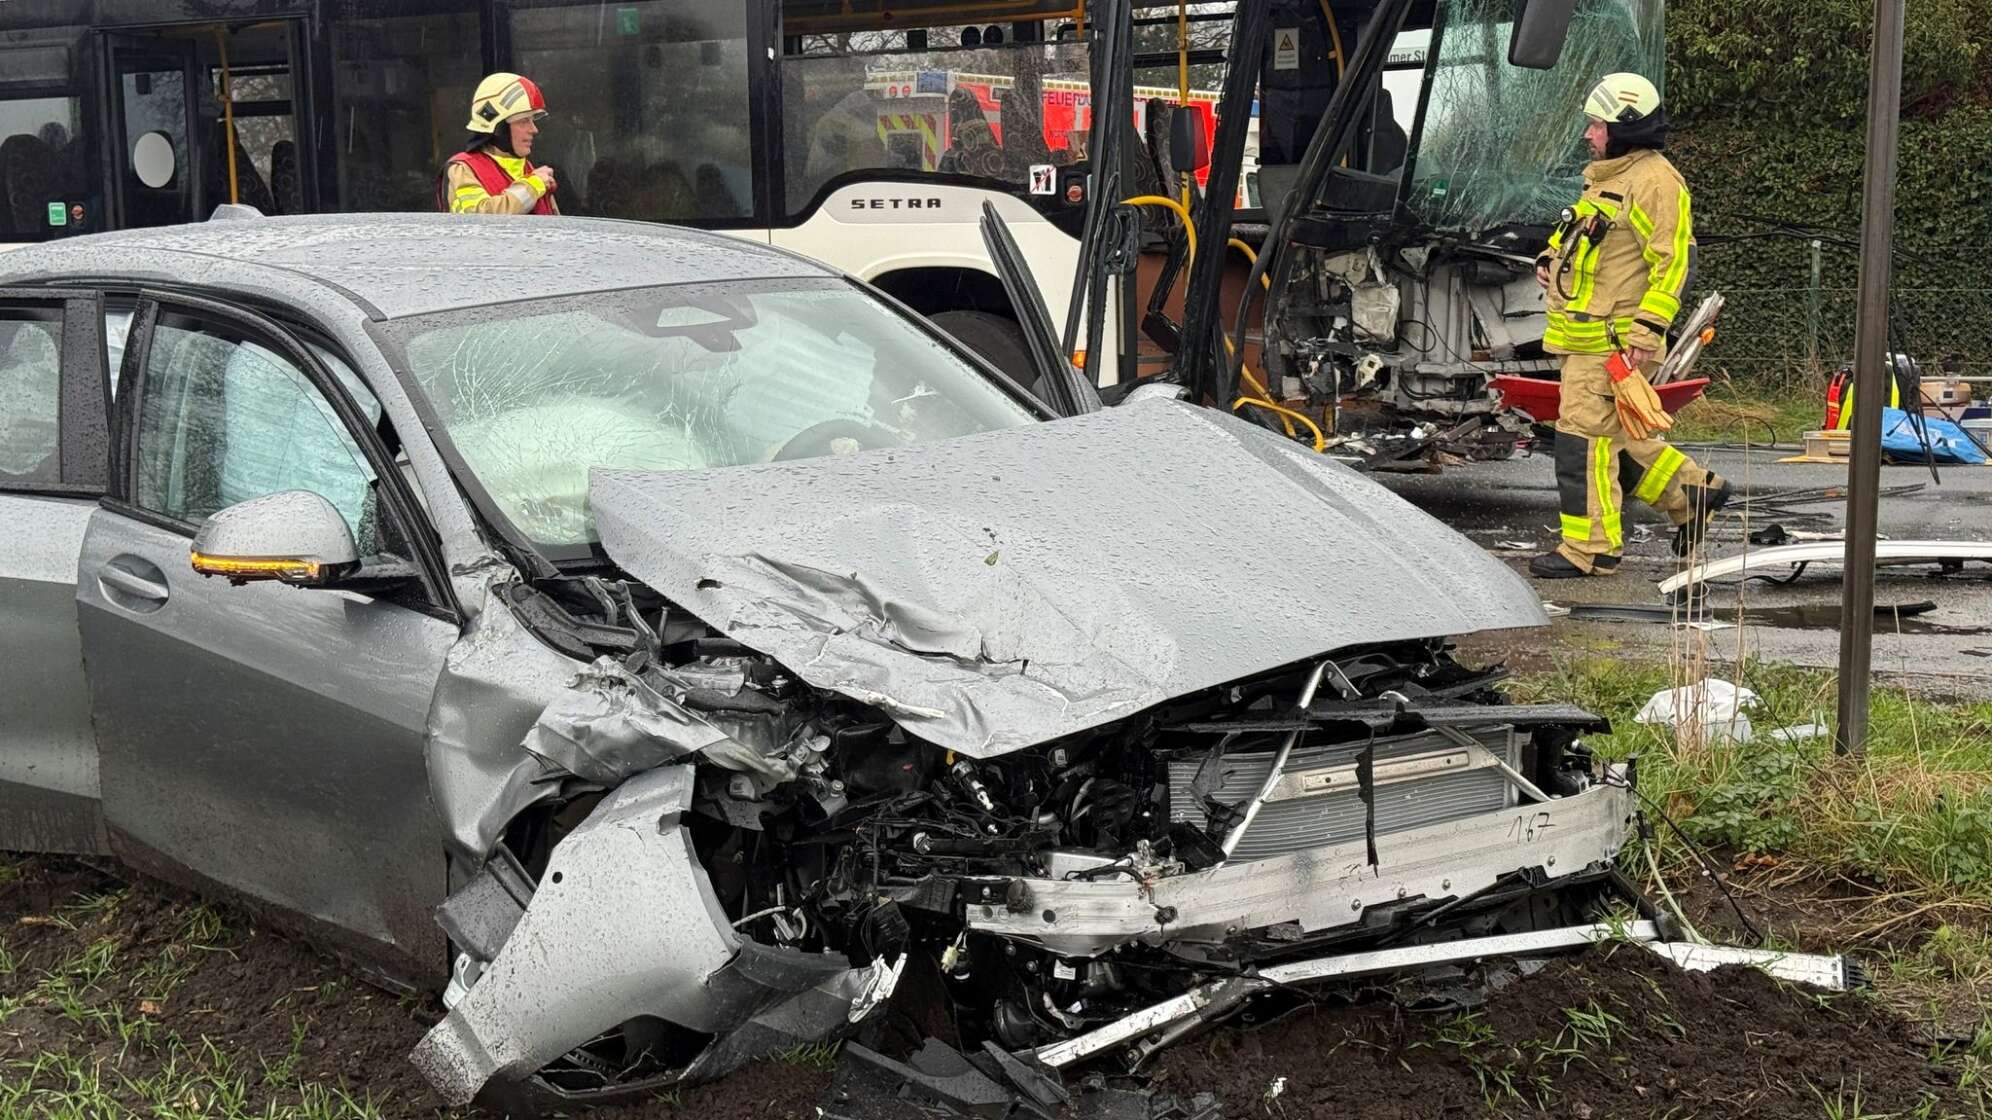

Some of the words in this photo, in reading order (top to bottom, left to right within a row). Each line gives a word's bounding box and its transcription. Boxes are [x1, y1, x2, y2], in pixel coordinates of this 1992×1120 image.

[1390, 54, 1411, 62] mer
[851, 198, 942, 209] SETRA
[1507, 812, 1556, 844] 167
